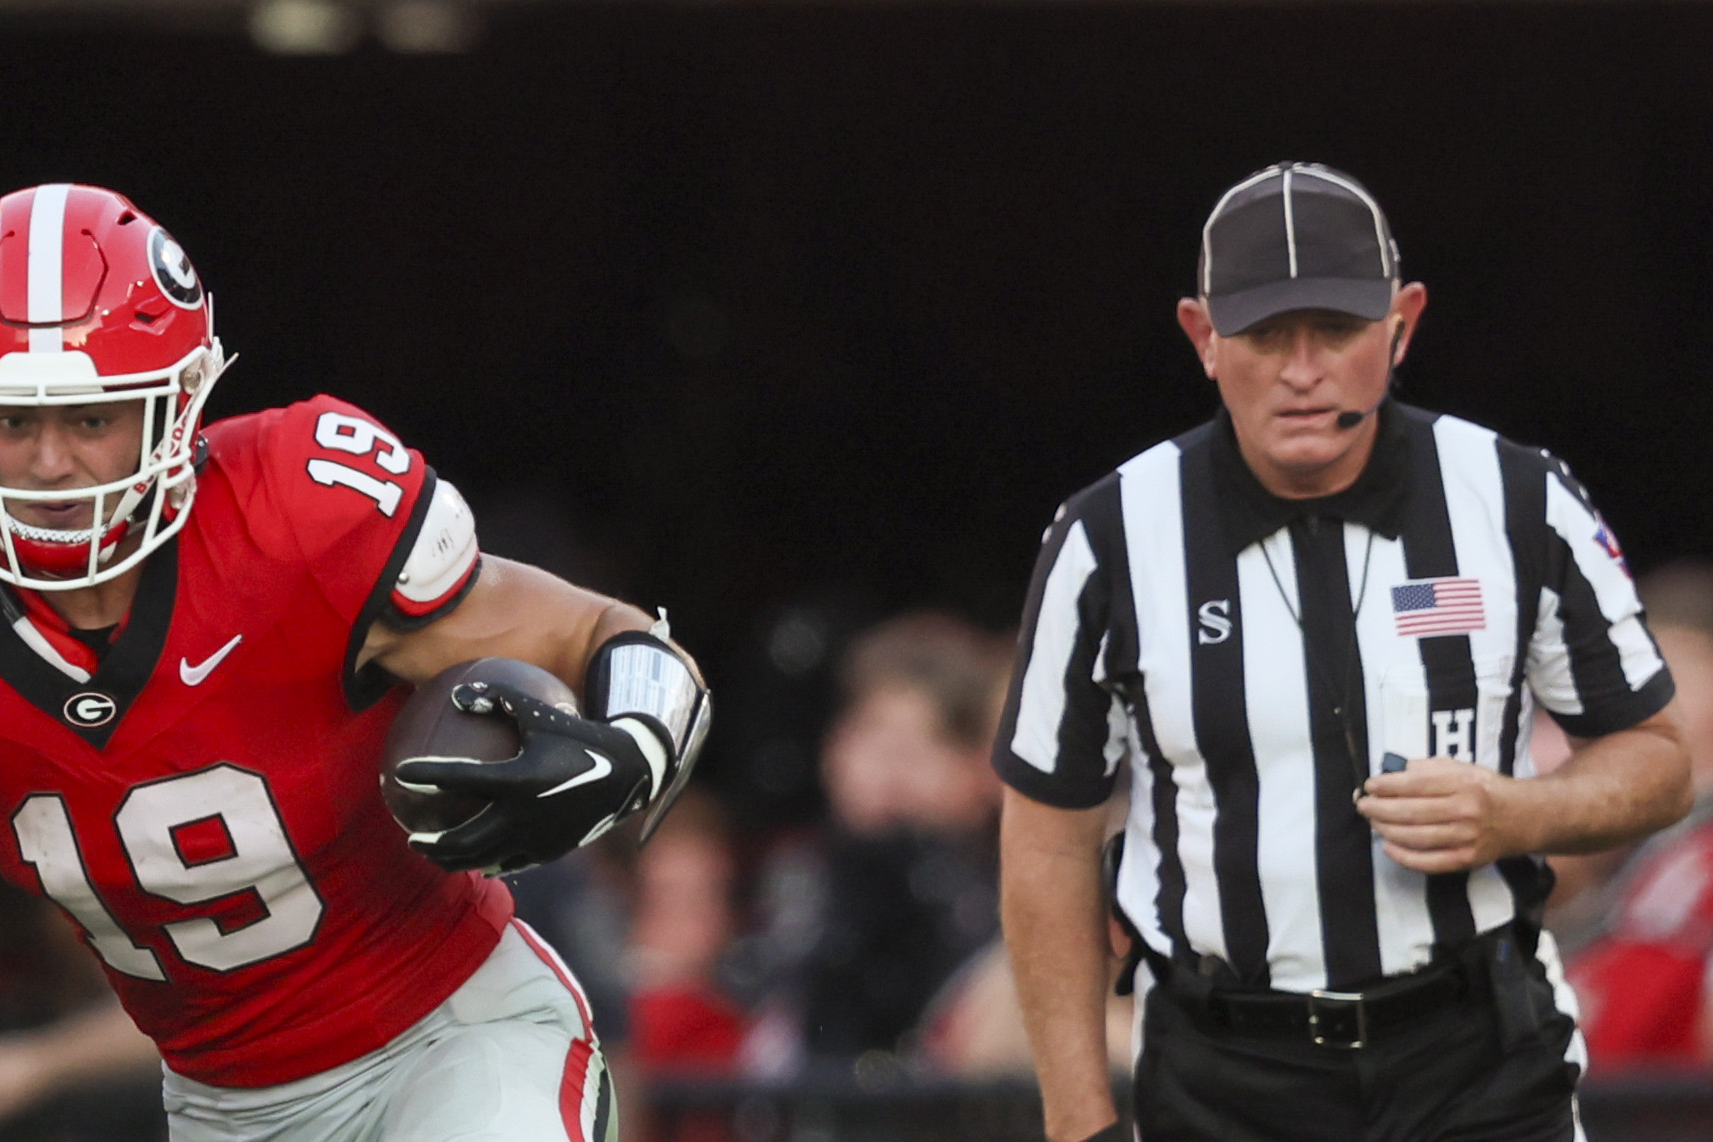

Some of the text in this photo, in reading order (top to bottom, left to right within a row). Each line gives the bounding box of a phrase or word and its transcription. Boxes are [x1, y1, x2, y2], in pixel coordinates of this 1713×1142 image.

[306, 410, 412, 520] 19
[1198, 599, 1233, 645] S
[1431, 707, 1475, 764] H
[10, 761, 326, 984] 19
